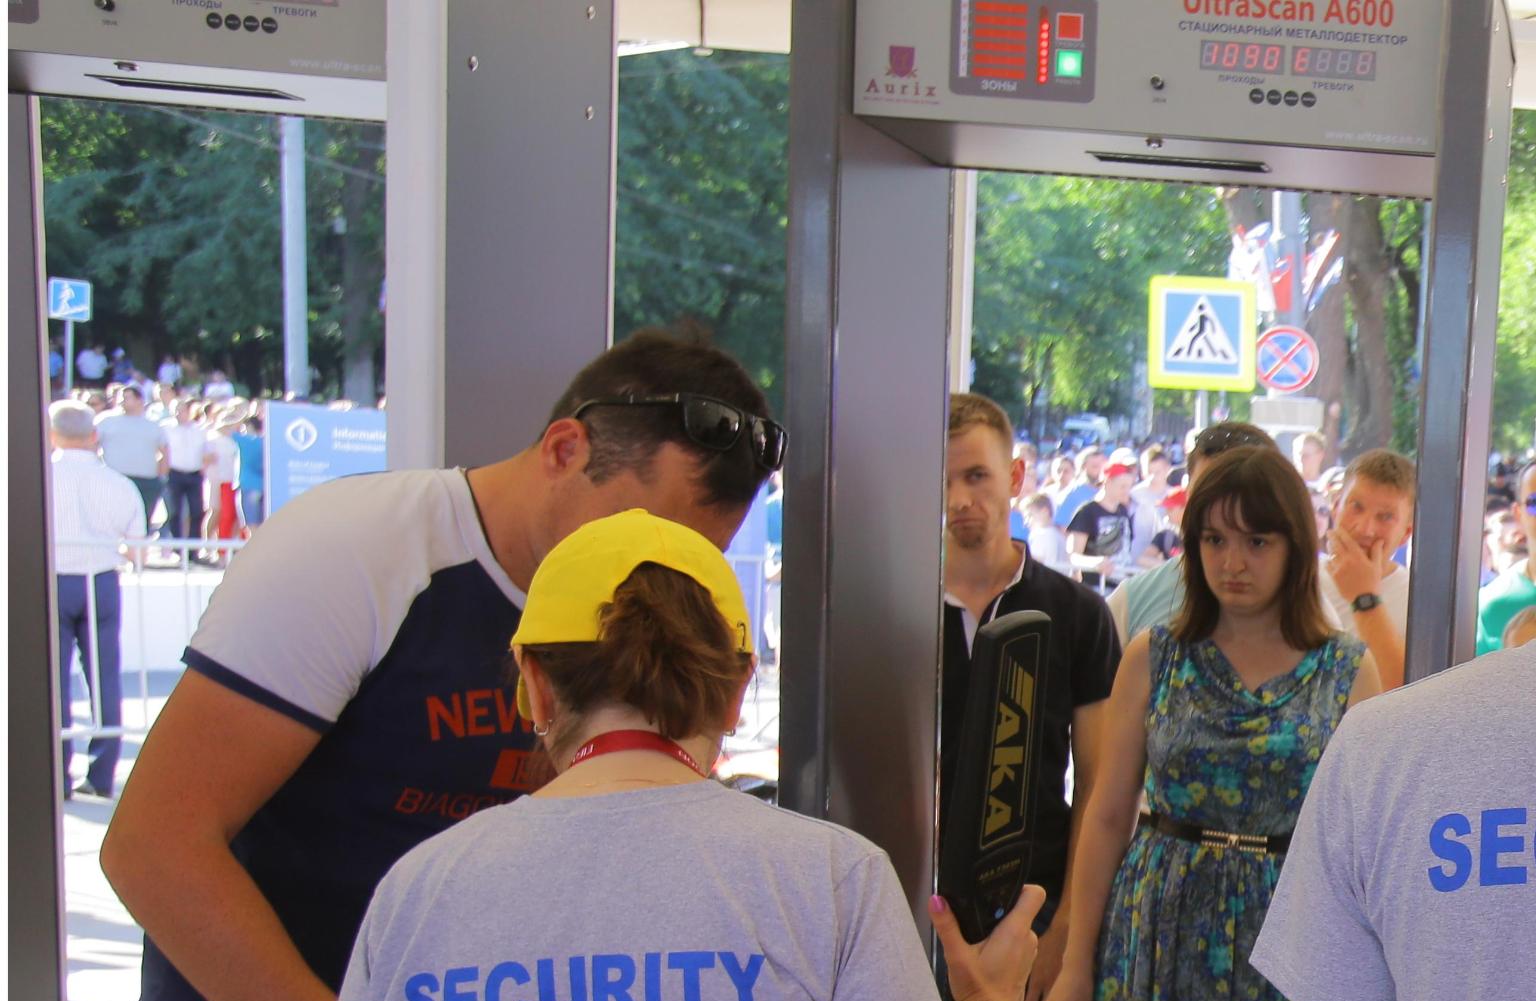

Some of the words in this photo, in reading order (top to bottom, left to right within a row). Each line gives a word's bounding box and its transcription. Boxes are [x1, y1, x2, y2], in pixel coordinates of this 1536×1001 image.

[273, 5, 318, 18] ТРЕВОГИ
[1323, 0, 1394, 28] A600
[1178, 20, 1283, 37] СТАЦИОНАРНЫЙ
[1285, 27, 1408, 46] МЕТАЛЛОДЕТЕКТОР
[981, 79, 1018, 92] ЗОНЫ
[1218, 74, 1265, 85] ПРОХОДЫ
[865, 78, 937, 97] Aurix
[1312, 81, 1354, 92] ТРЕВОГИ
